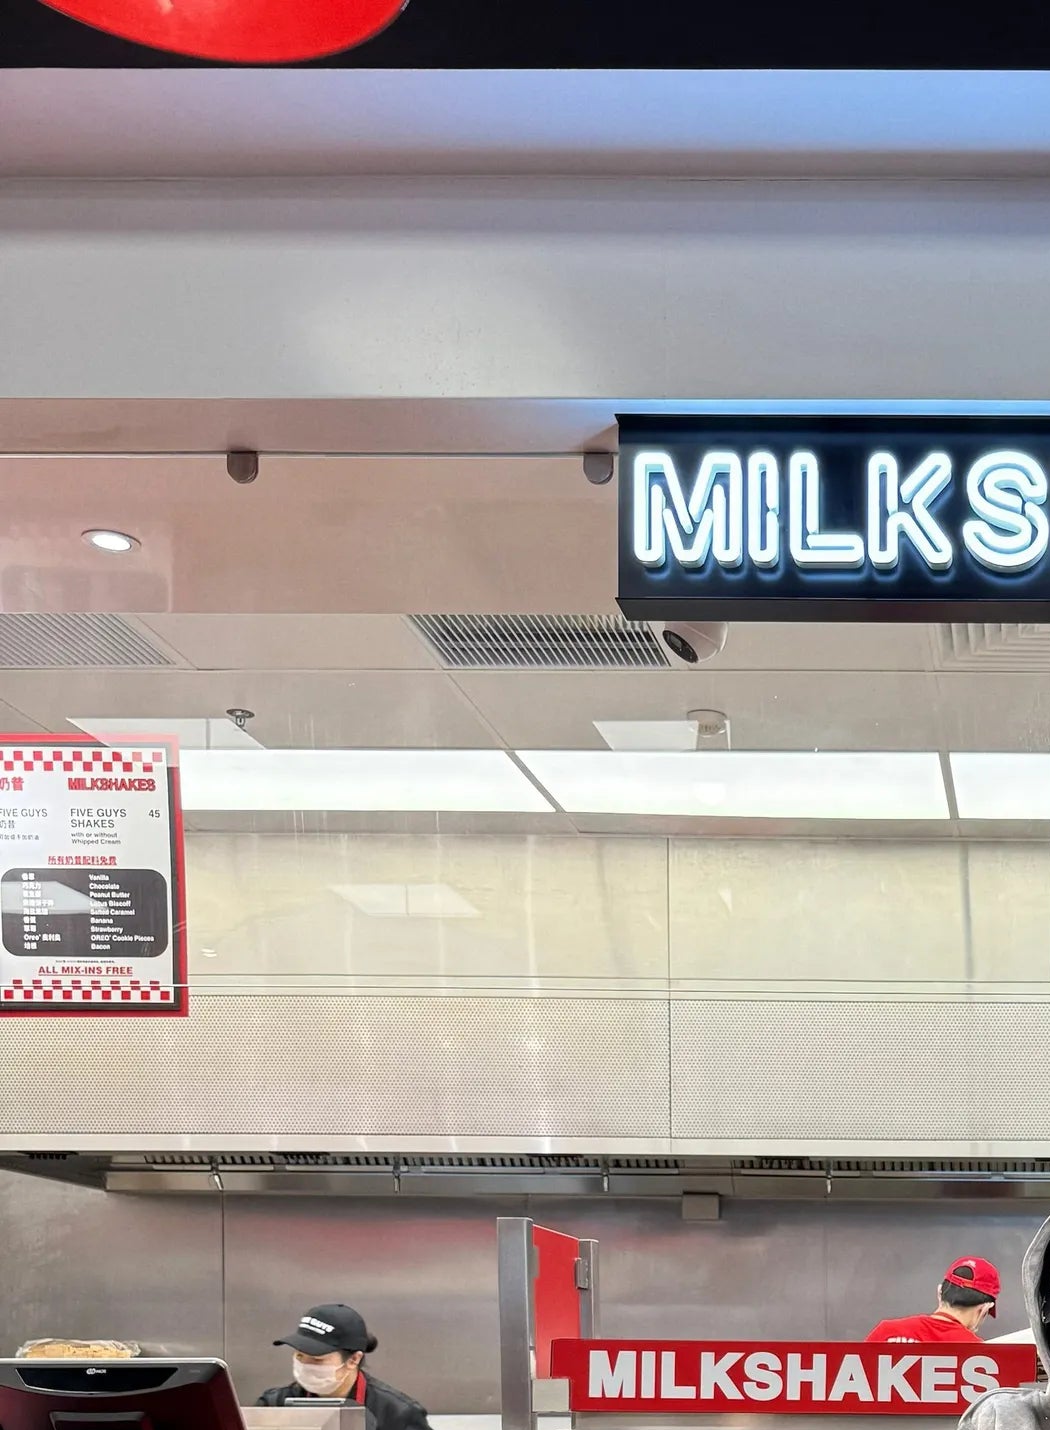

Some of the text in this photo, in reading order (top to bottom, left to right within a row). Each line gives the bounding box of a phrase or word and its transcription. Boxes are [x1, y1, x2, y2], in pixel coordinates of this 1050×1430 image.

[68, 777, 156, 791] MILKSHAKES
[20, 808, 48, 817] GUYS
[70, 808, 127, 818] FIVE GUYS
[148, 809, 161, 818] 45
[70, 819, 115, 828] SHAKES
[38, 966, 133, 975] ALL MIX-INS FREE
[588, 1350, 1000, 1404] MILKSHAKES
